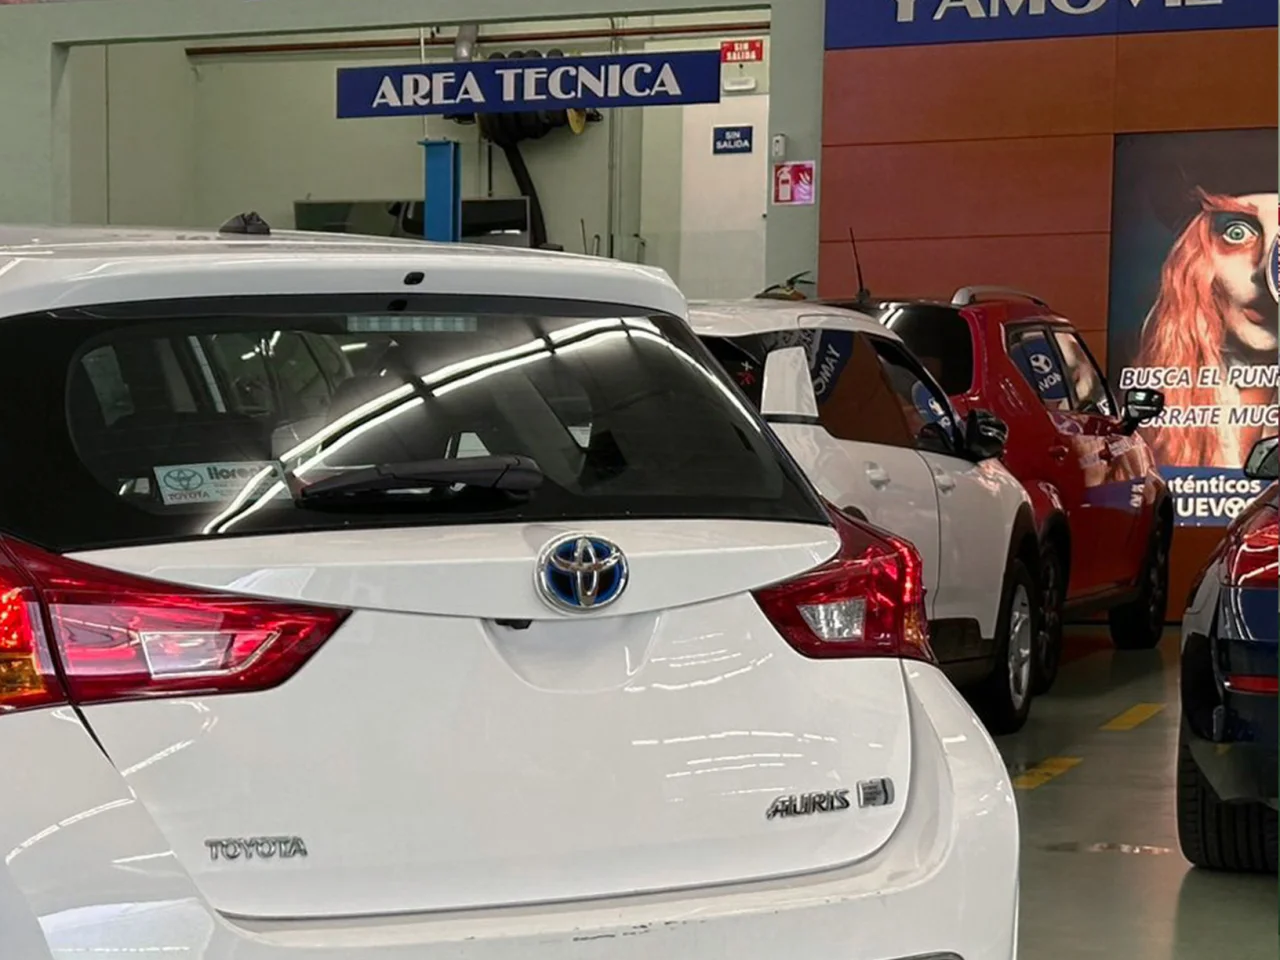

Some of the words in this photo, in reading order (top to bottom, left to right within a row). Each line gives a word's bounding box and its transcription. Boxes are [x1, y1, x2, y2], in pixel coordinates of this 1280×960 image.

[372, 71, 485, 108] AREA
[495, 62, 682, 101] TECNICA
[716, 139, 750, 149] SALIDA
[725, 131, 741, 140] SIN
[1121, 367, 1190, 388] BUSCA
[1199, 367, 1220, 387] EL
[766, 789, 851, 820] AURIS
[205, 836, 308, 860] TOYOTA
